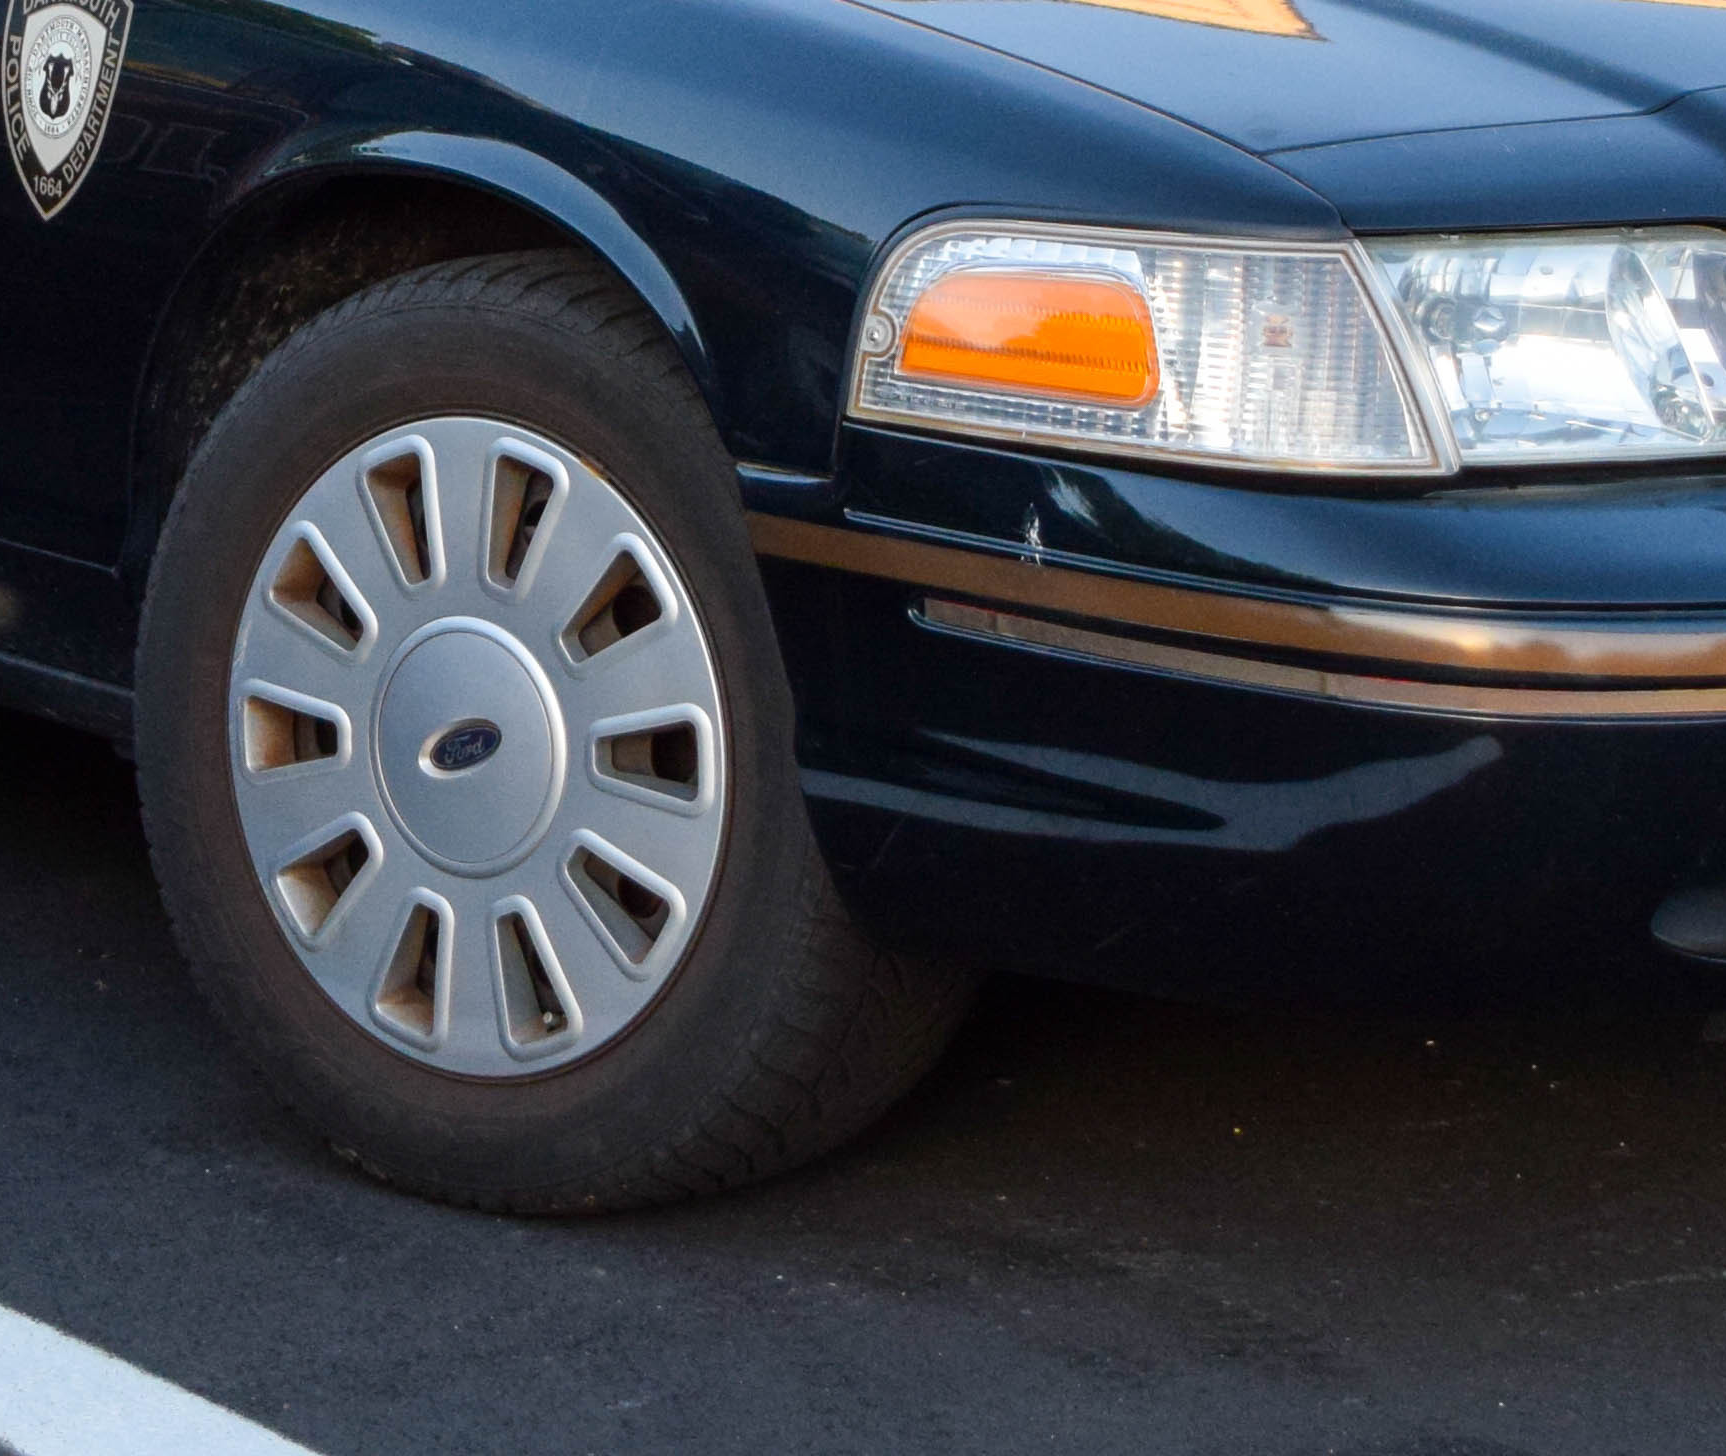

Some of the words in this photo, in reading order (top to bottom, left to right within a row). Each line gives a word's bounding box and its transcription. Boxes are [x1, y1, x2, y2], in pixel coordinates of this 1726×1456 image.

[5, 34, 31, 162] POLICE
[61, 35, 122, 184] DEPARTMENT
[32, 174, 63, 198] 1664
[443, 733, 484, 765] Ford
